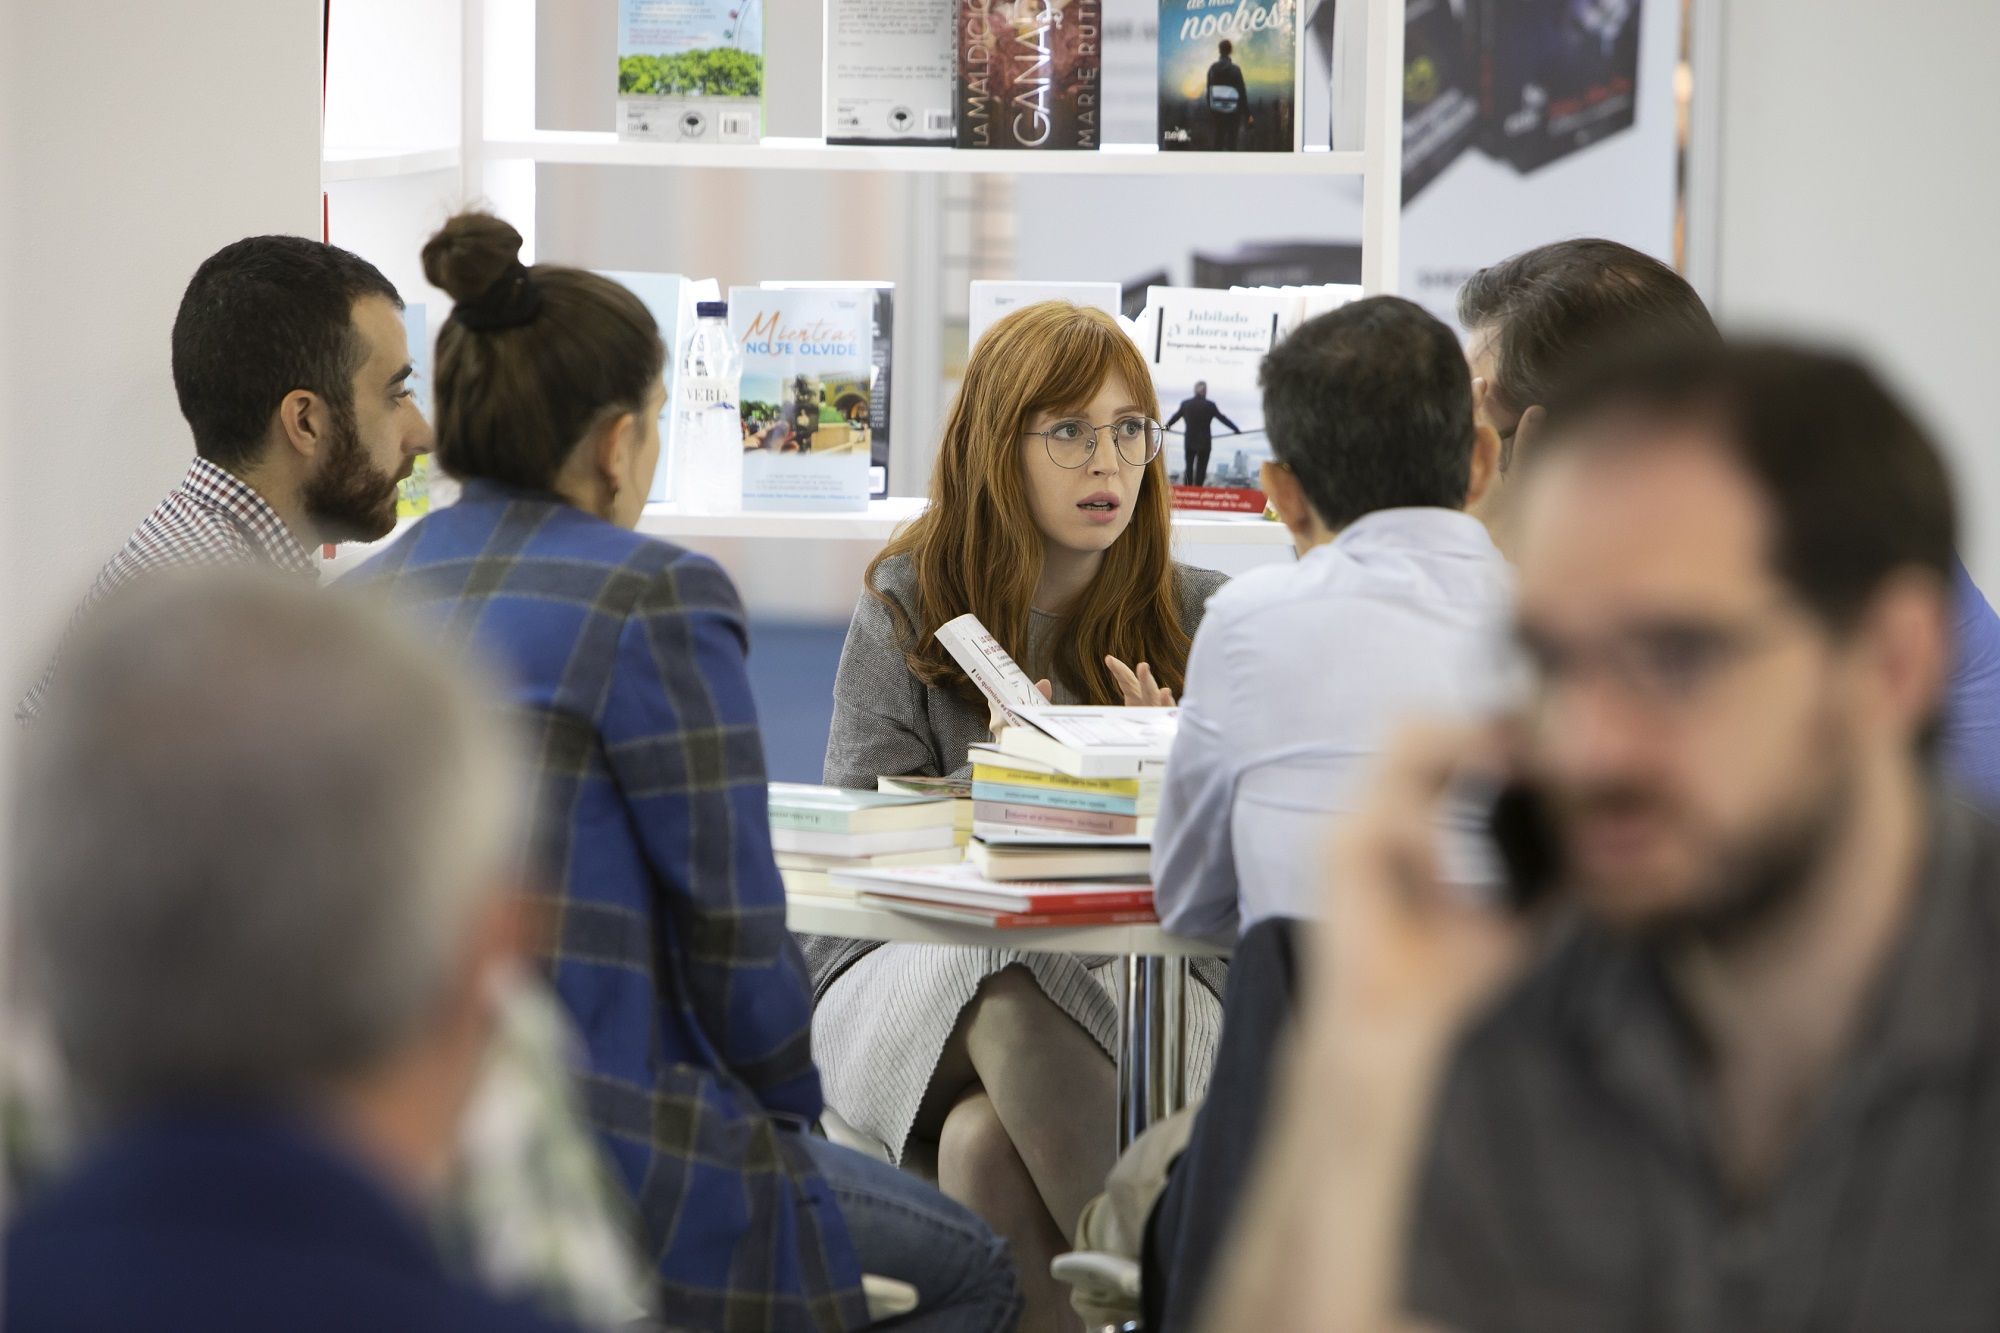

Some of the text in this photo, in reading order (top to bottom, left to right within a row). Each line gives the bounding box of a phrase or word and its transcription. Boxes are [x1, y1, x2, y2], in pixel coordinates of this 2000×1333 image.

[1181, 0, 1280, 41] noches
[1078, 0, 1097, 148] MARIE RUT
[973, 124, 990, 146] LA
[1188, 309, 1248, 323] Jubilado
[741, 309, 857, 357] Mientras
[1187, 325, 1228, 337] ahora
[746, 342, 857, 356] NO TE OLVIDE
